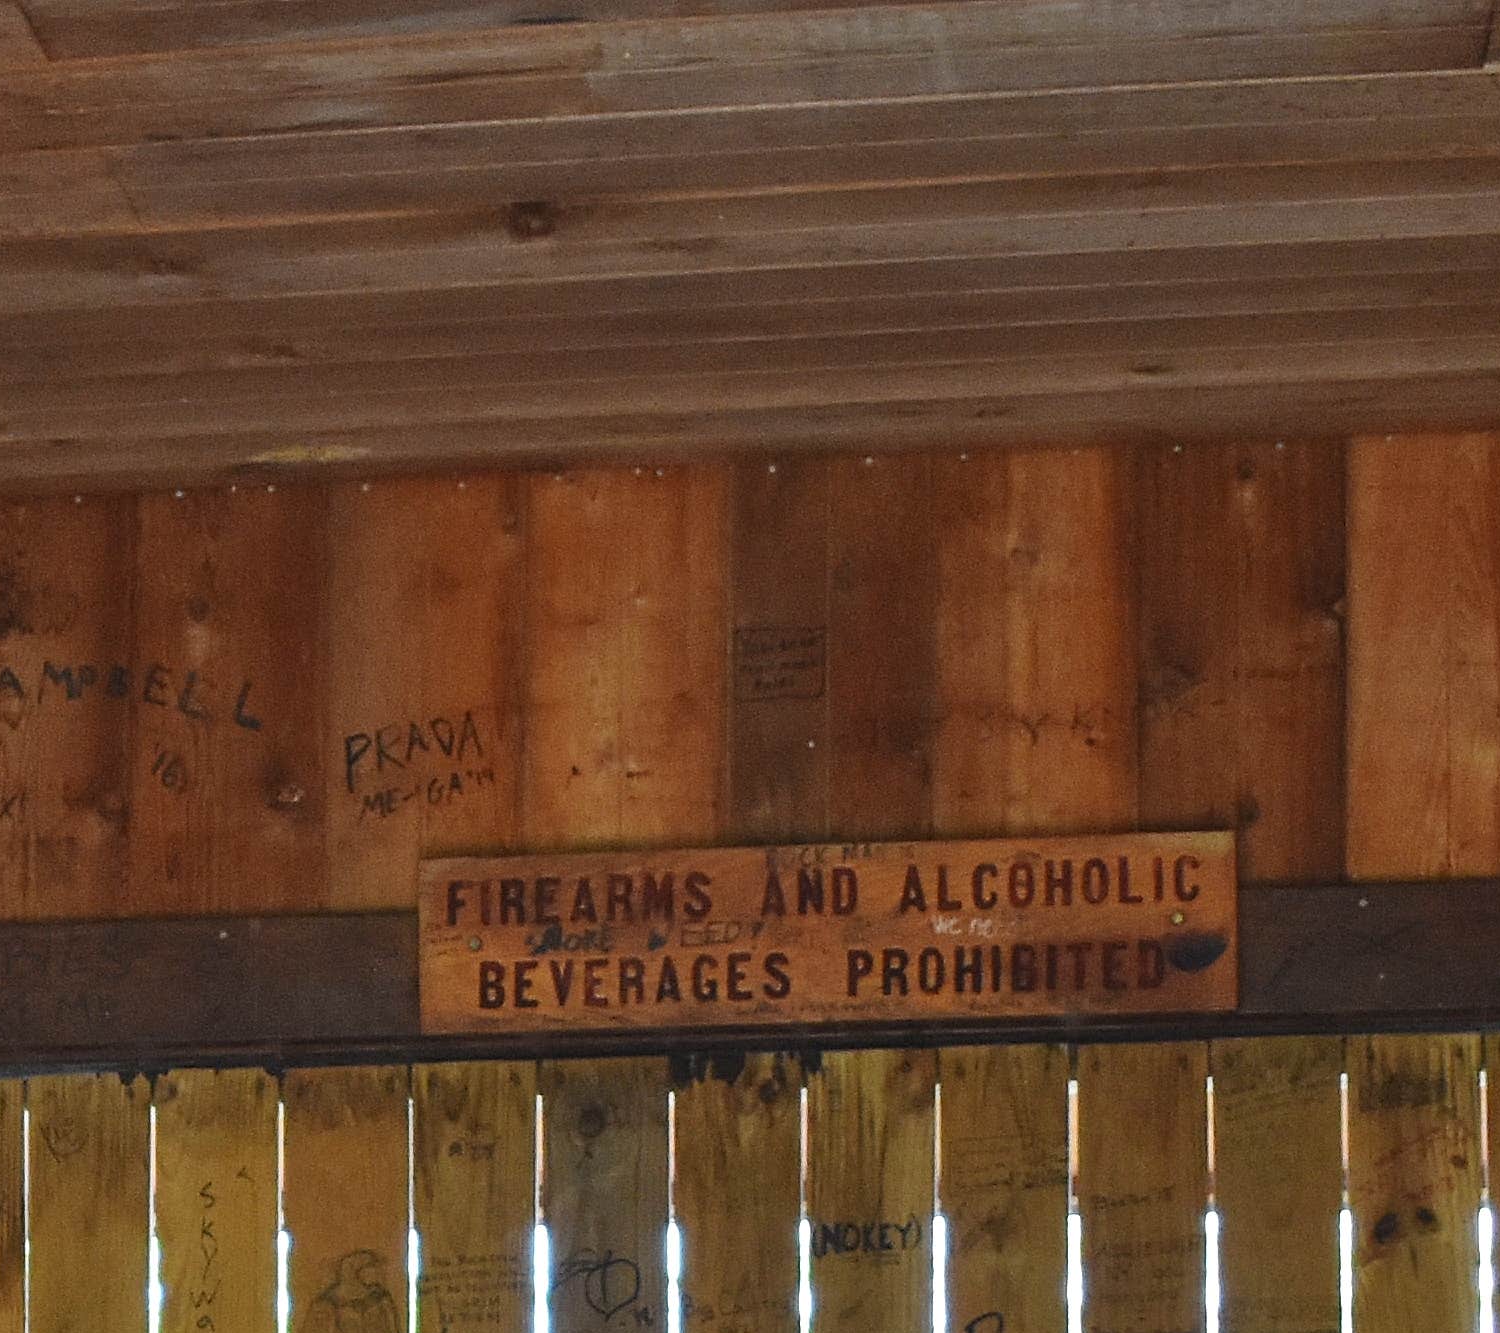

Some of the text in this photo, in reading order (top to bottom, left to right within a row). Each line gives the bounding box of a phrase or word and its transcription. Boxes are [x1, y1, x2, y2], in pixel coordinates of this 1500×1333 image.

[345, 710, 484, 794] PRADA
[445, 854, 1203, 930] FIREARMS AND ALCOHOLIC
[477, 940, 1168, 1011] BEVERAGES PROHIBITED
